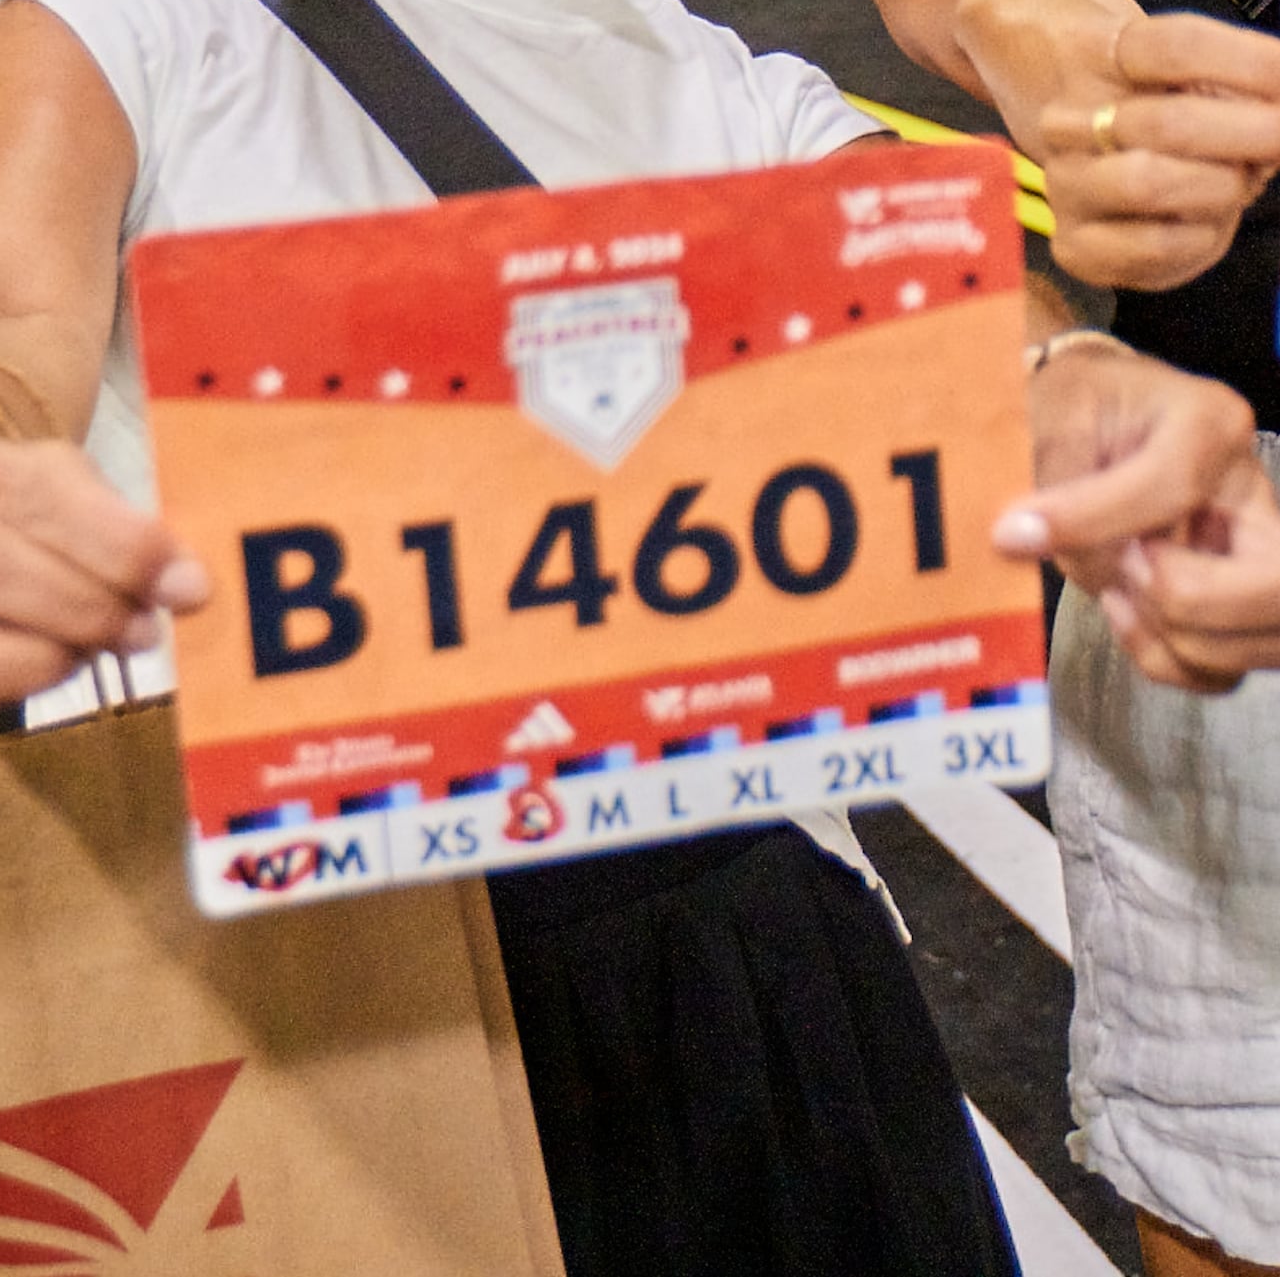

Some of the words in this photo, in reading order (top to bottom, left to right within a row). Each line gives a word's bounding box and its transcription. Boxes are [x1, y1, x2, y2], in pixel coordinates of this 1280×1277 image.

[240, 447, 948, 679] B14601
[315, 837, 368, 881] M
[420, 816, 479, 862] XS
[588, 791, 630, 833] M
[668, 781, 688, 819] L
[731, 765, 783, 806] XL
[821, 745, 905, 794] 2XL
[943, 729, 1025, 775] 3XL
